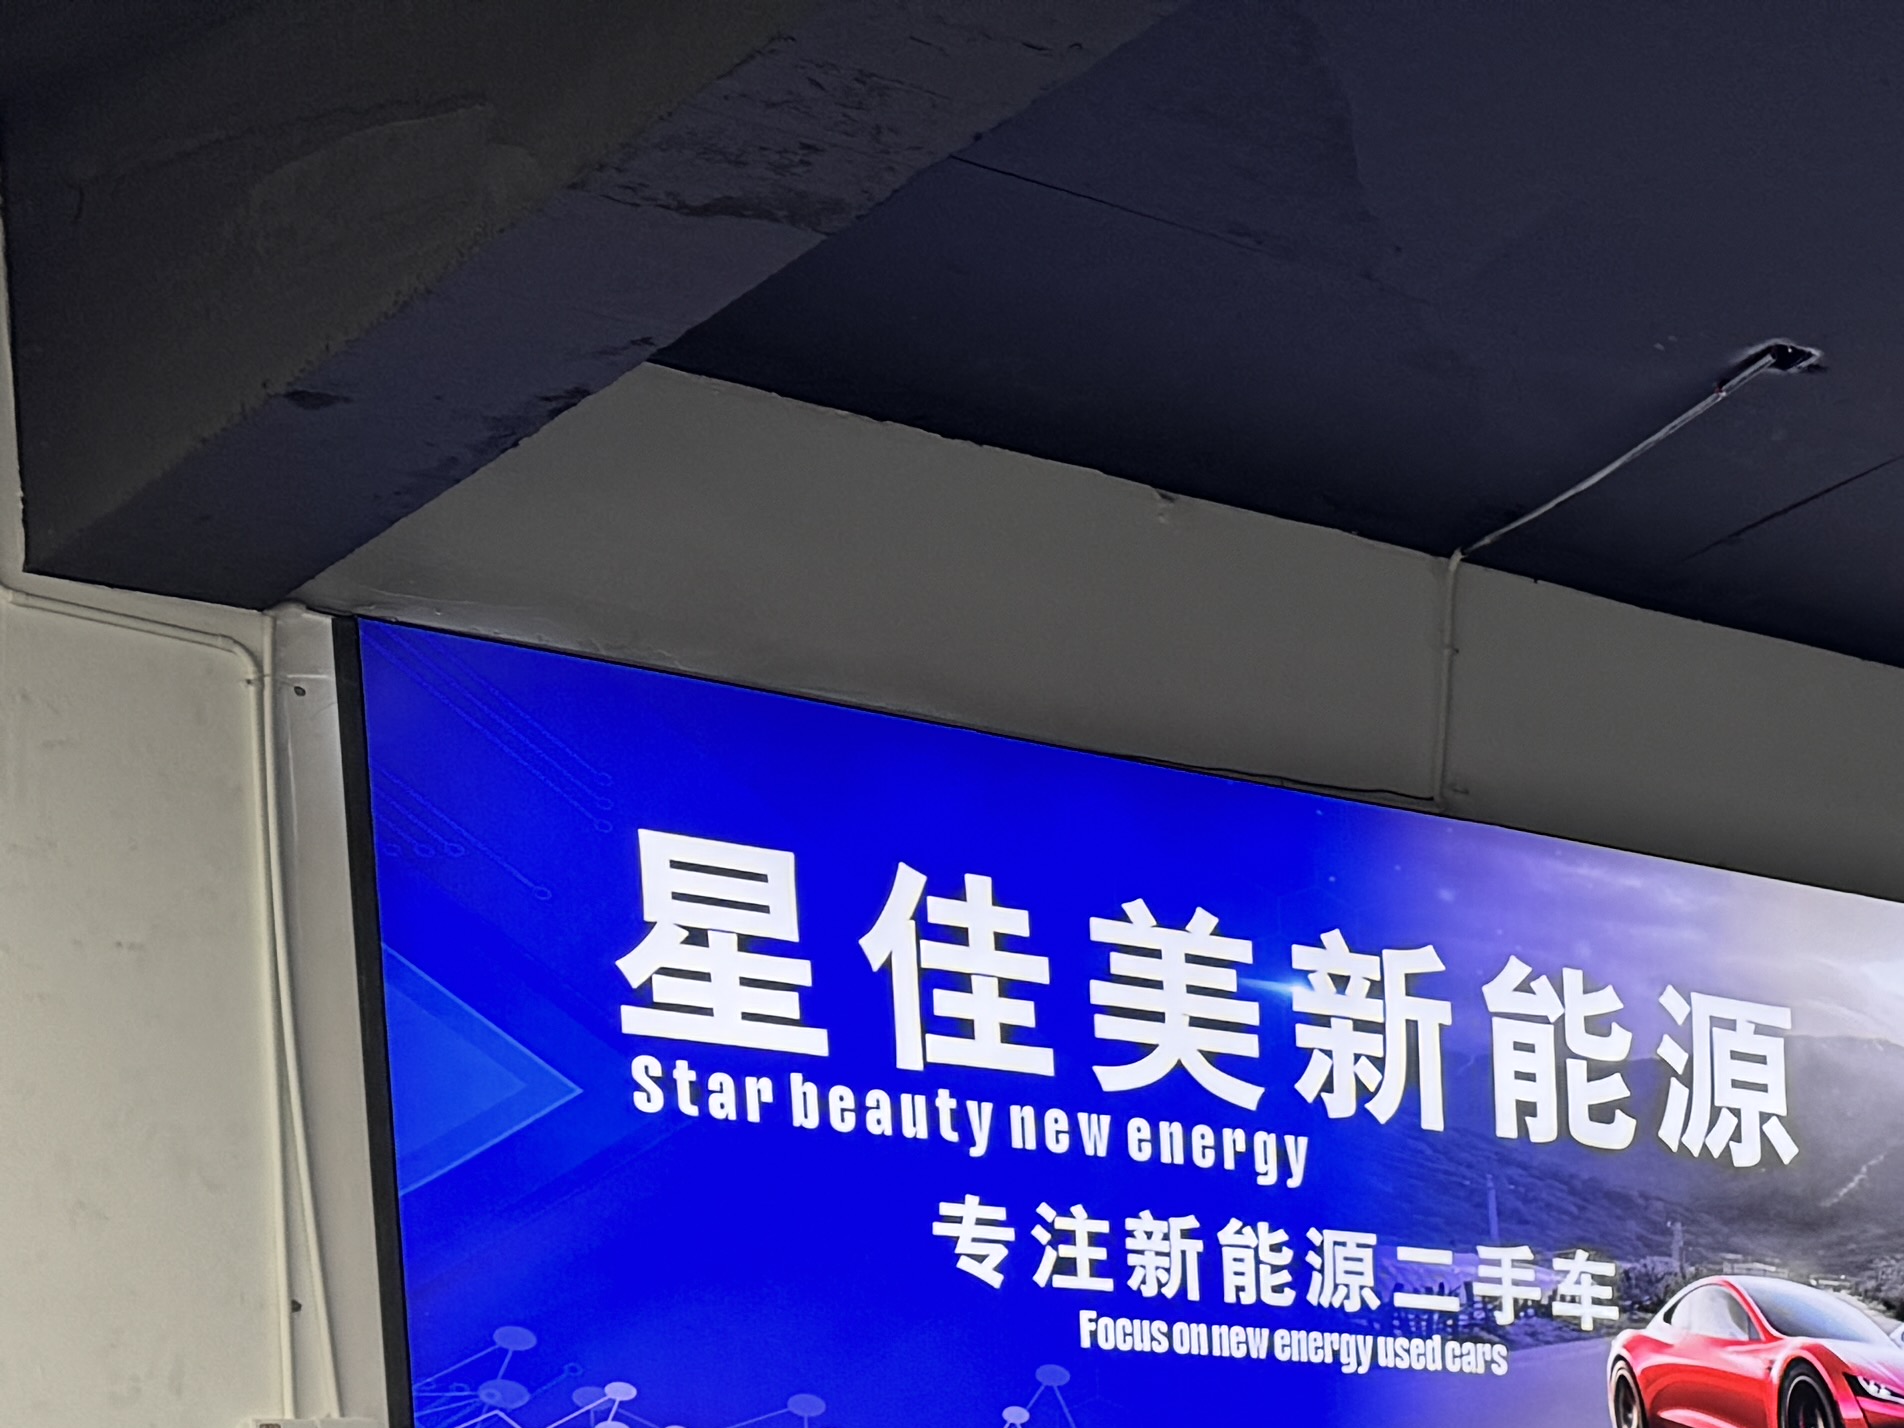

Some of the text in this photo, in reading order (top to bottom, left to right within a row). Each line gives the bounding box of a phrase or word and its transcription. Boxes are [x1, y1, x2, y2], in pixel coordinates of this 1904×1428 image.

[614, 827, 1800, 1169] 星佳美新能源
[630, 1053, 1308, 1188] Star beauty new energy
[931, 1192, 1621, 1332] 专注新能源二手车
[1078, 1308, 1509, 1377] Focus on new energy used cars
